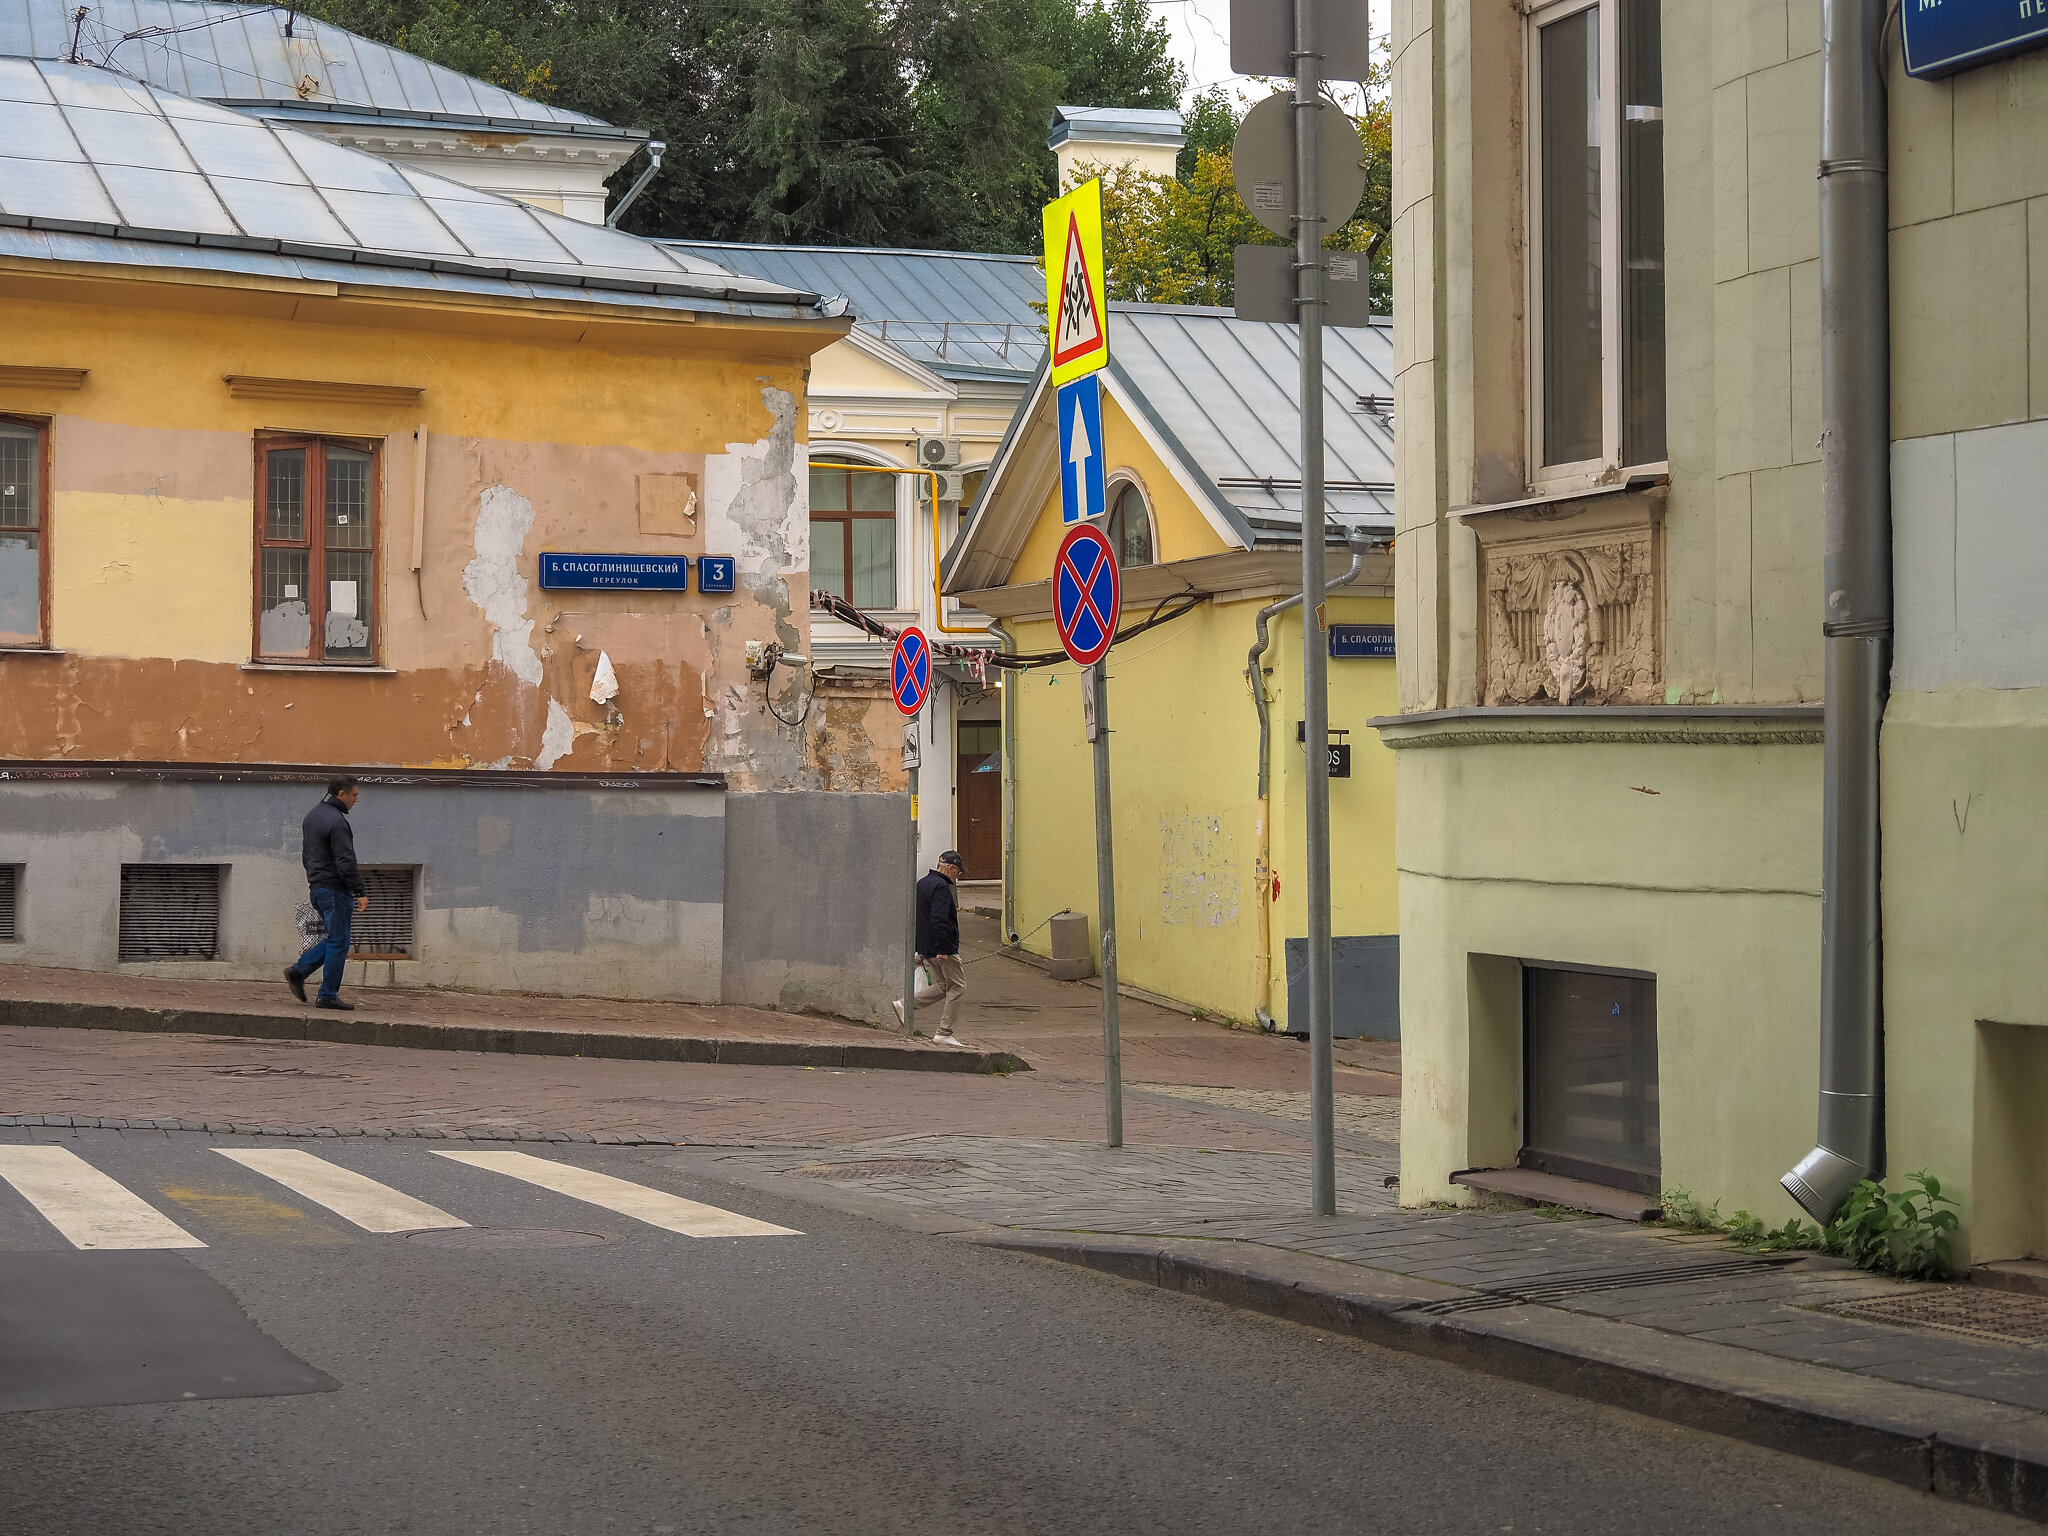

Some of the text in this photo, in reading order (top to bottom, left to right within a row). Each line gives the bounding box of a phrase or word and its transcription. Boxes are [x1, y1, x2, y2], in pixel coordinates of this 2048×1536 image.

[552, 562, 678, 573] Б. СПАСОГЛИНИЩЕВСКИЙ
[713, 563, 724, 581] 3
[1342, 634, 1395, 644] Б. СПАСОГЛИ
